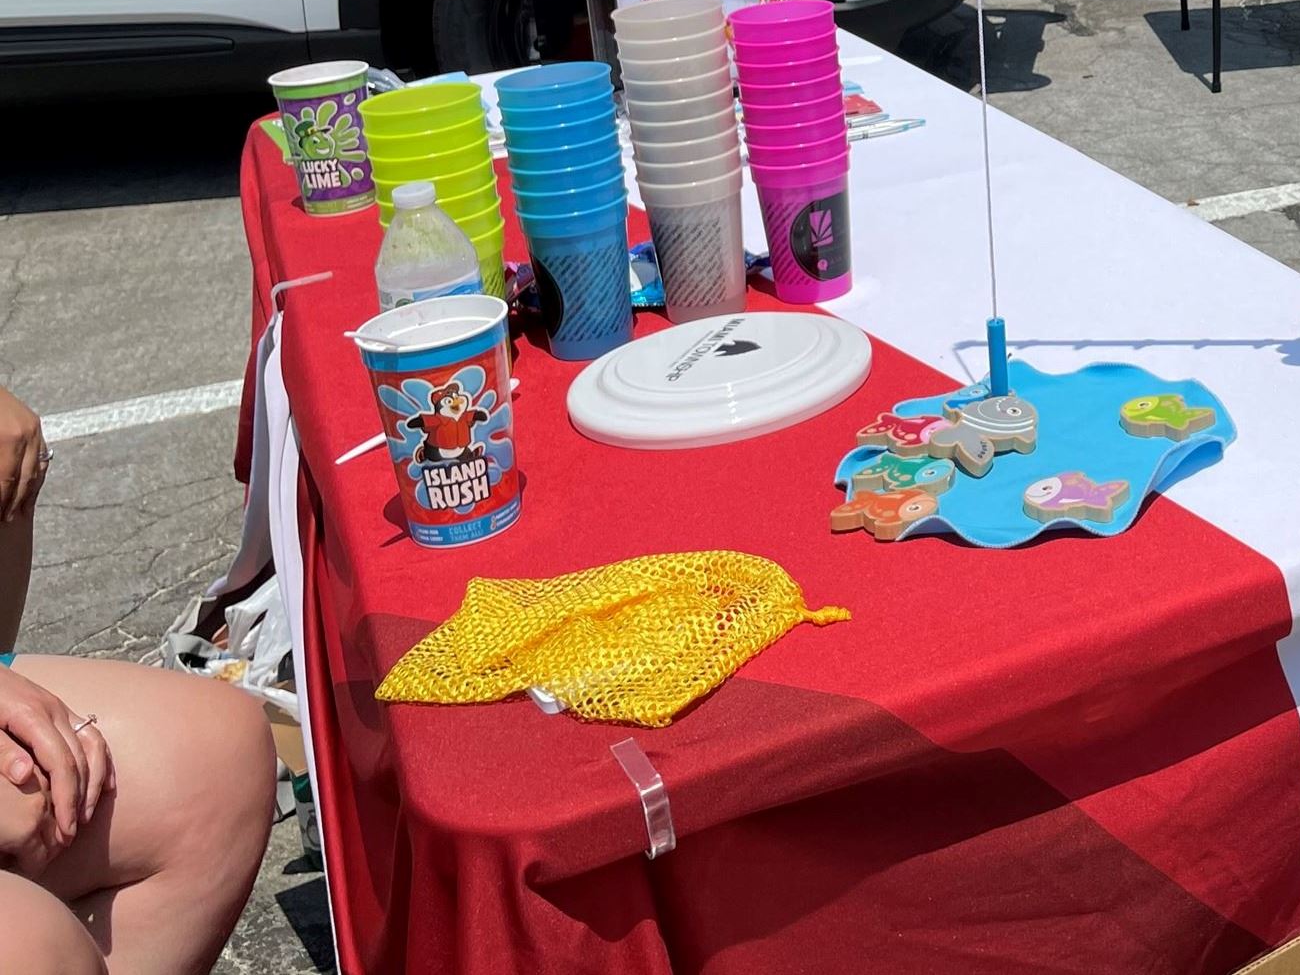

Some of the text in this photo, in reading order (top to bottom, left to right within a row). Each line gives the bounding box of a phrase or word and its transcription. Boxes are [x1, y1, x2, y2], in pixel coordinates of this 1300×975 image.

[302, 159, 338, 173] LUCKY
[305, 171, 342, 189] LIME
[424, 458, 487, 487] ISLAND
[428, 475, 490, 510] RUSH
